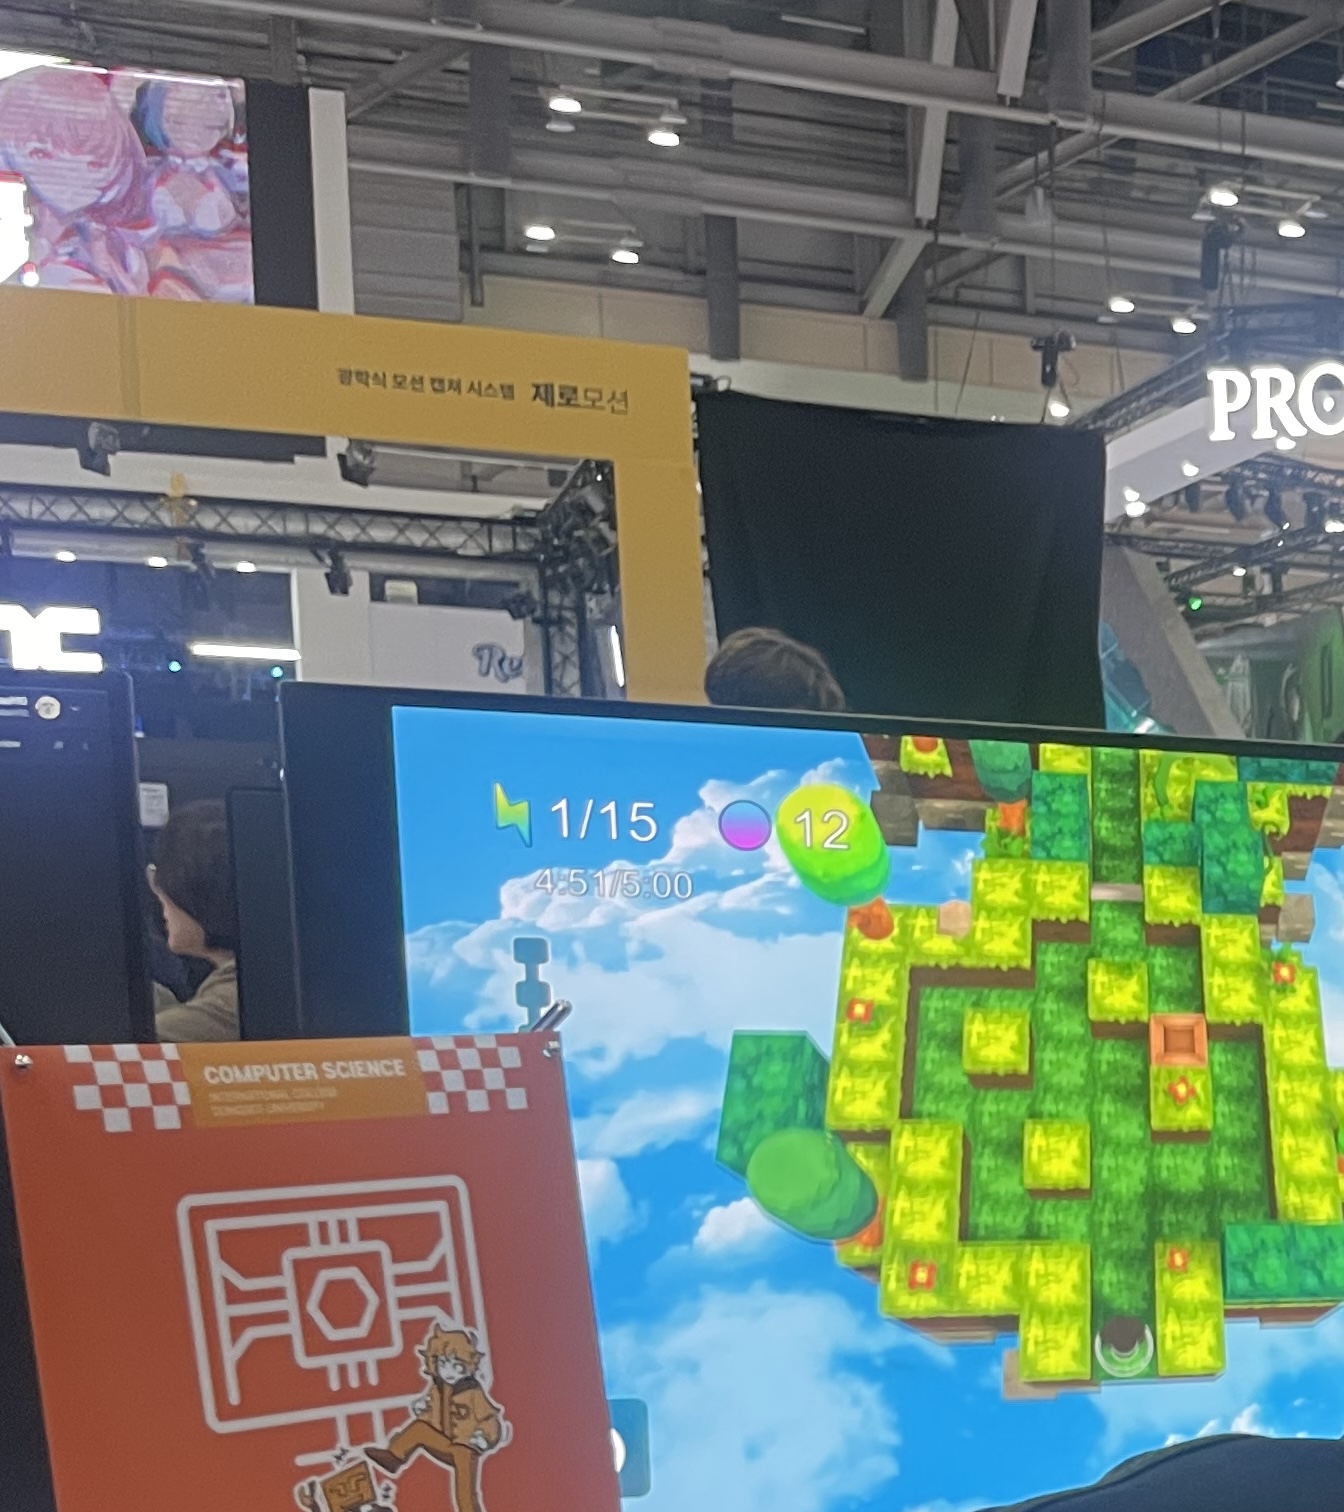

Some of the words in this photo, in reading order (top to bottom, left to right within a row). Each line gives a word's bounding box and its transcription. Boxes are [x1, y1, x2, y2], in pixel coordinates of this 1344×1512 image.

[392, 373, 425, 393] 모션
[467, 379, 515, 401] 시스템
[531, 381, 628, 416] 제로모션
[551, 798, 659, 843] 1/15
[793, 811, 851, 851] 12
[533, 867, 695, 901] 4:51/5:00
[203, 1062, 318, 1085] COMPUTER
[321, 1058, 406, 1080] SCIENCE
